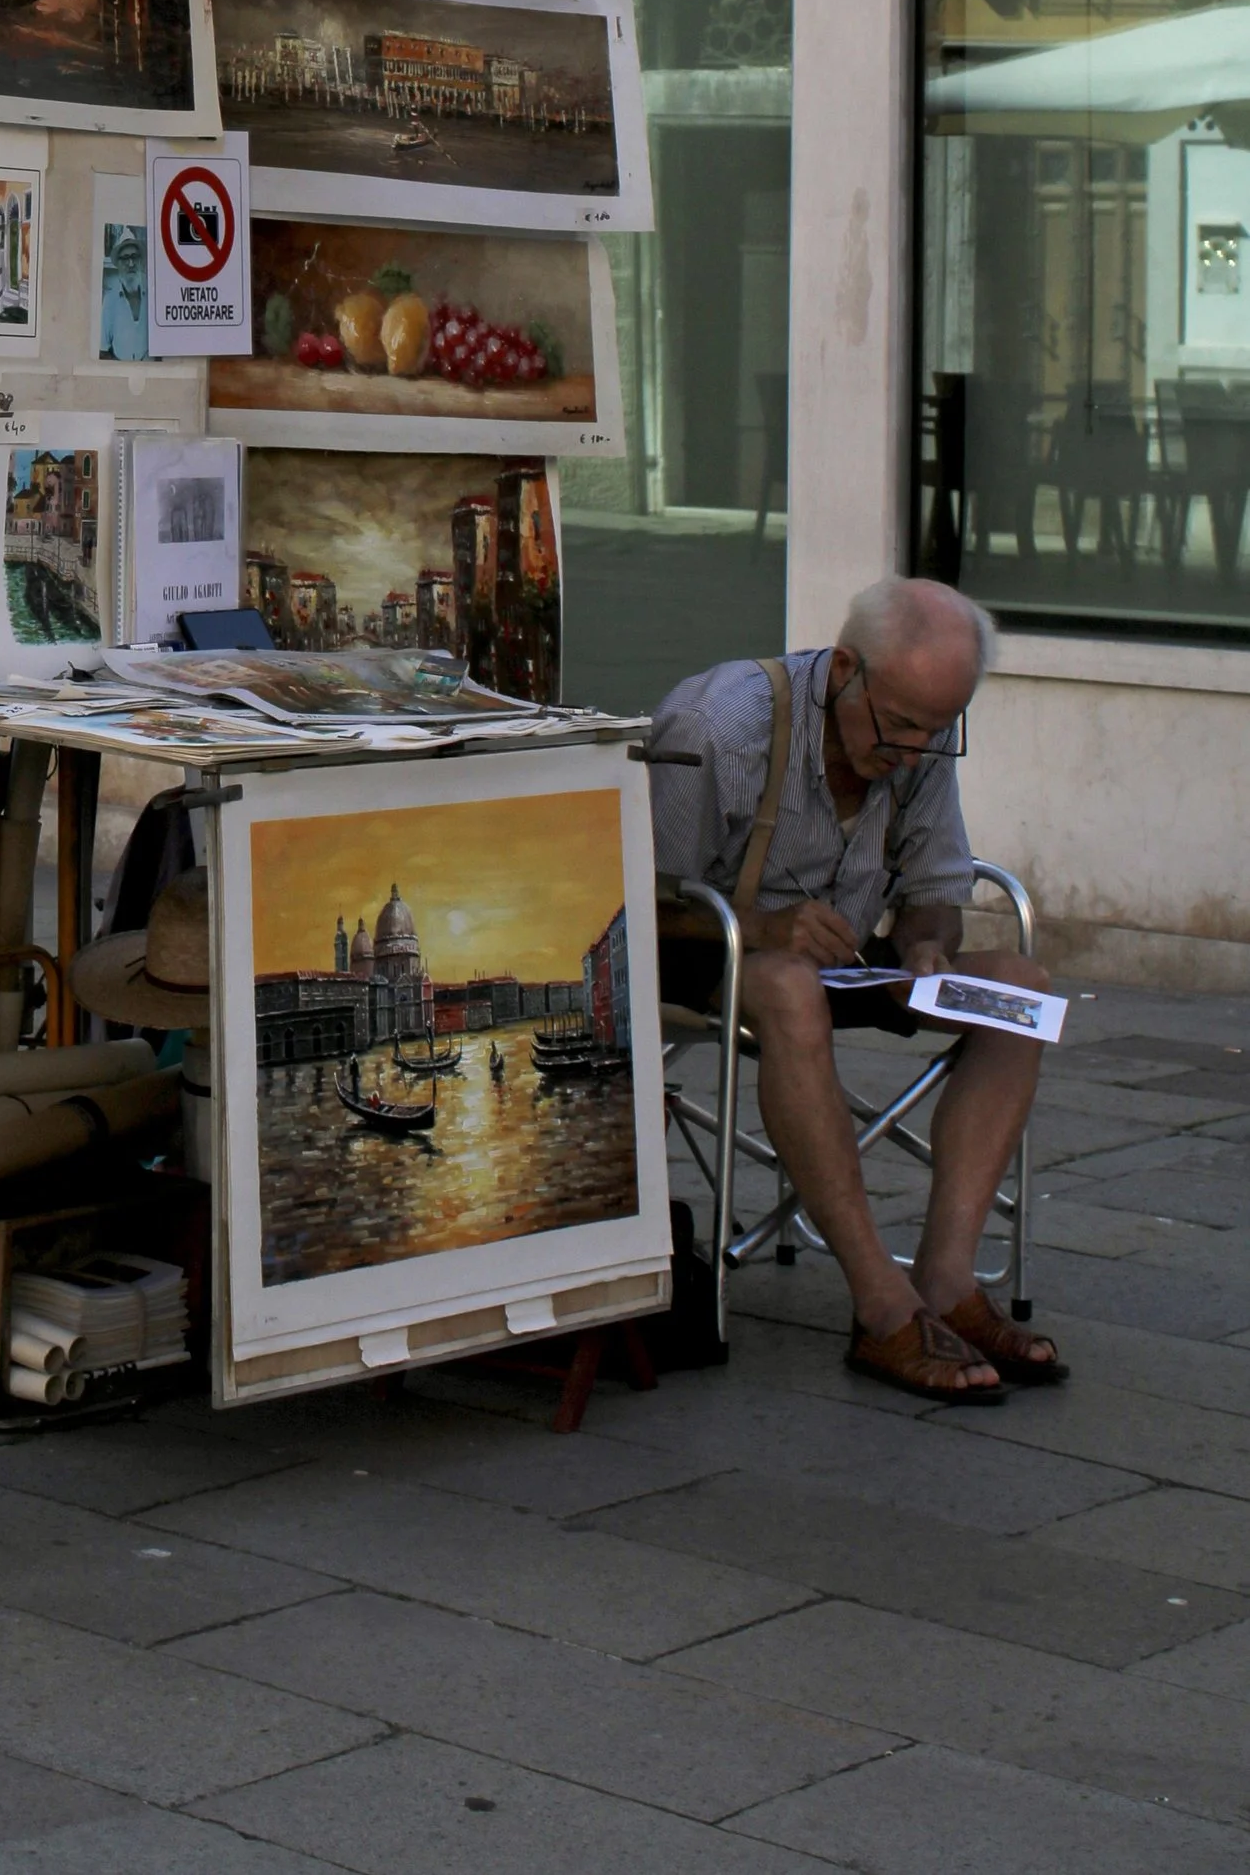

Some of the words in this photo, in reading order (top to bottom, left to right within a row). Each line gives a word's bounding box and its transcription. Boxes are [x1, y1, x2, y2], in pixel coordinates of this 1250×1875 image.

[180, 287, 219, 302] VIETATO
[165, 305, 234, 321] FOTOGRAFARE
[162, 585, 189, 601] GIULIO
